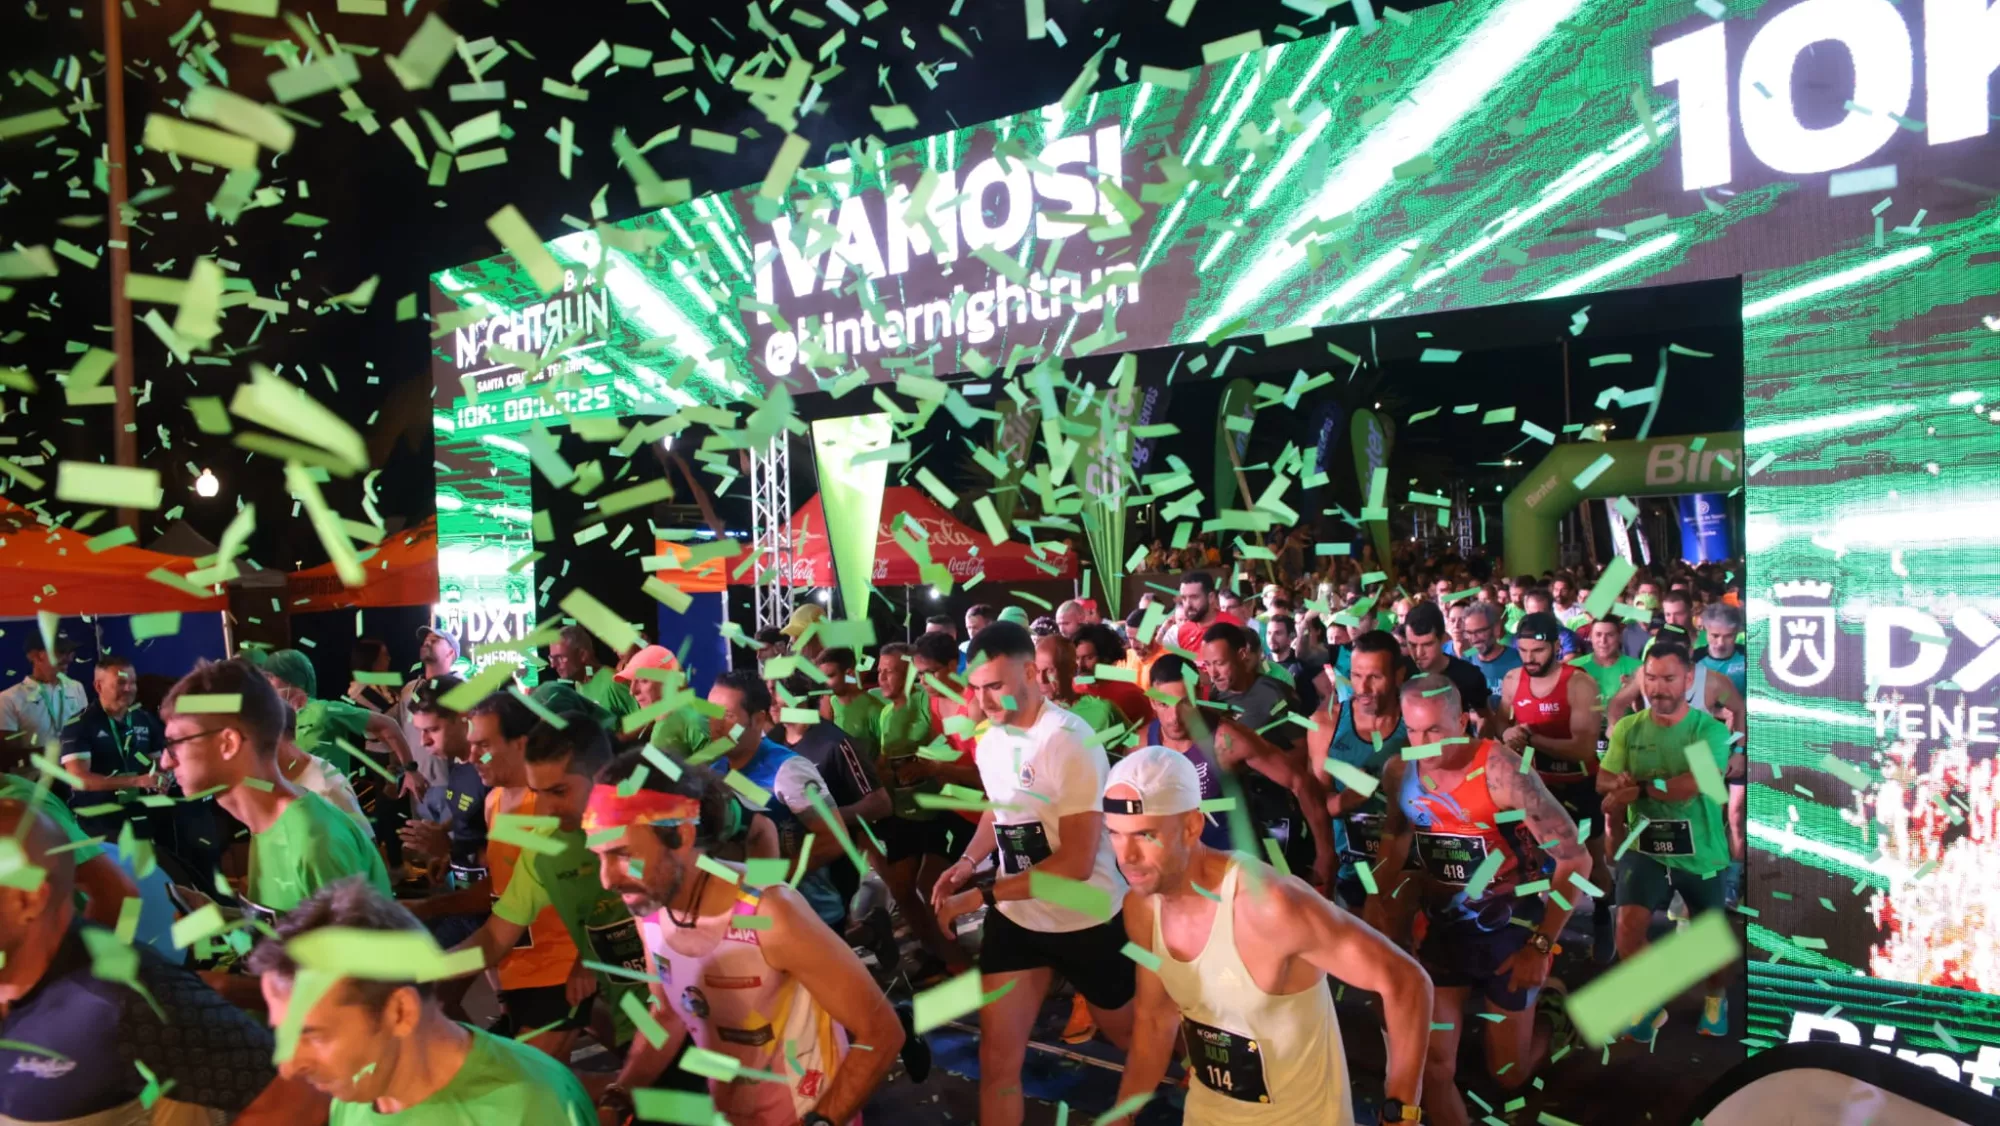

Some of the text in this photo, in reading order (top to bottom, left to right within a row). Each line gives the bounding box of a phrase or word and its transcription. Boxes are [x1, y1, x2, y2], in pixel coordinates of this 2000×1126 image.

[506, 371, 530, 387] CRU
[467, 599, 529, 644] DXT
[1443, 863, 1466, 879] 418
[1206, 1064, 1234, 1092] 114
